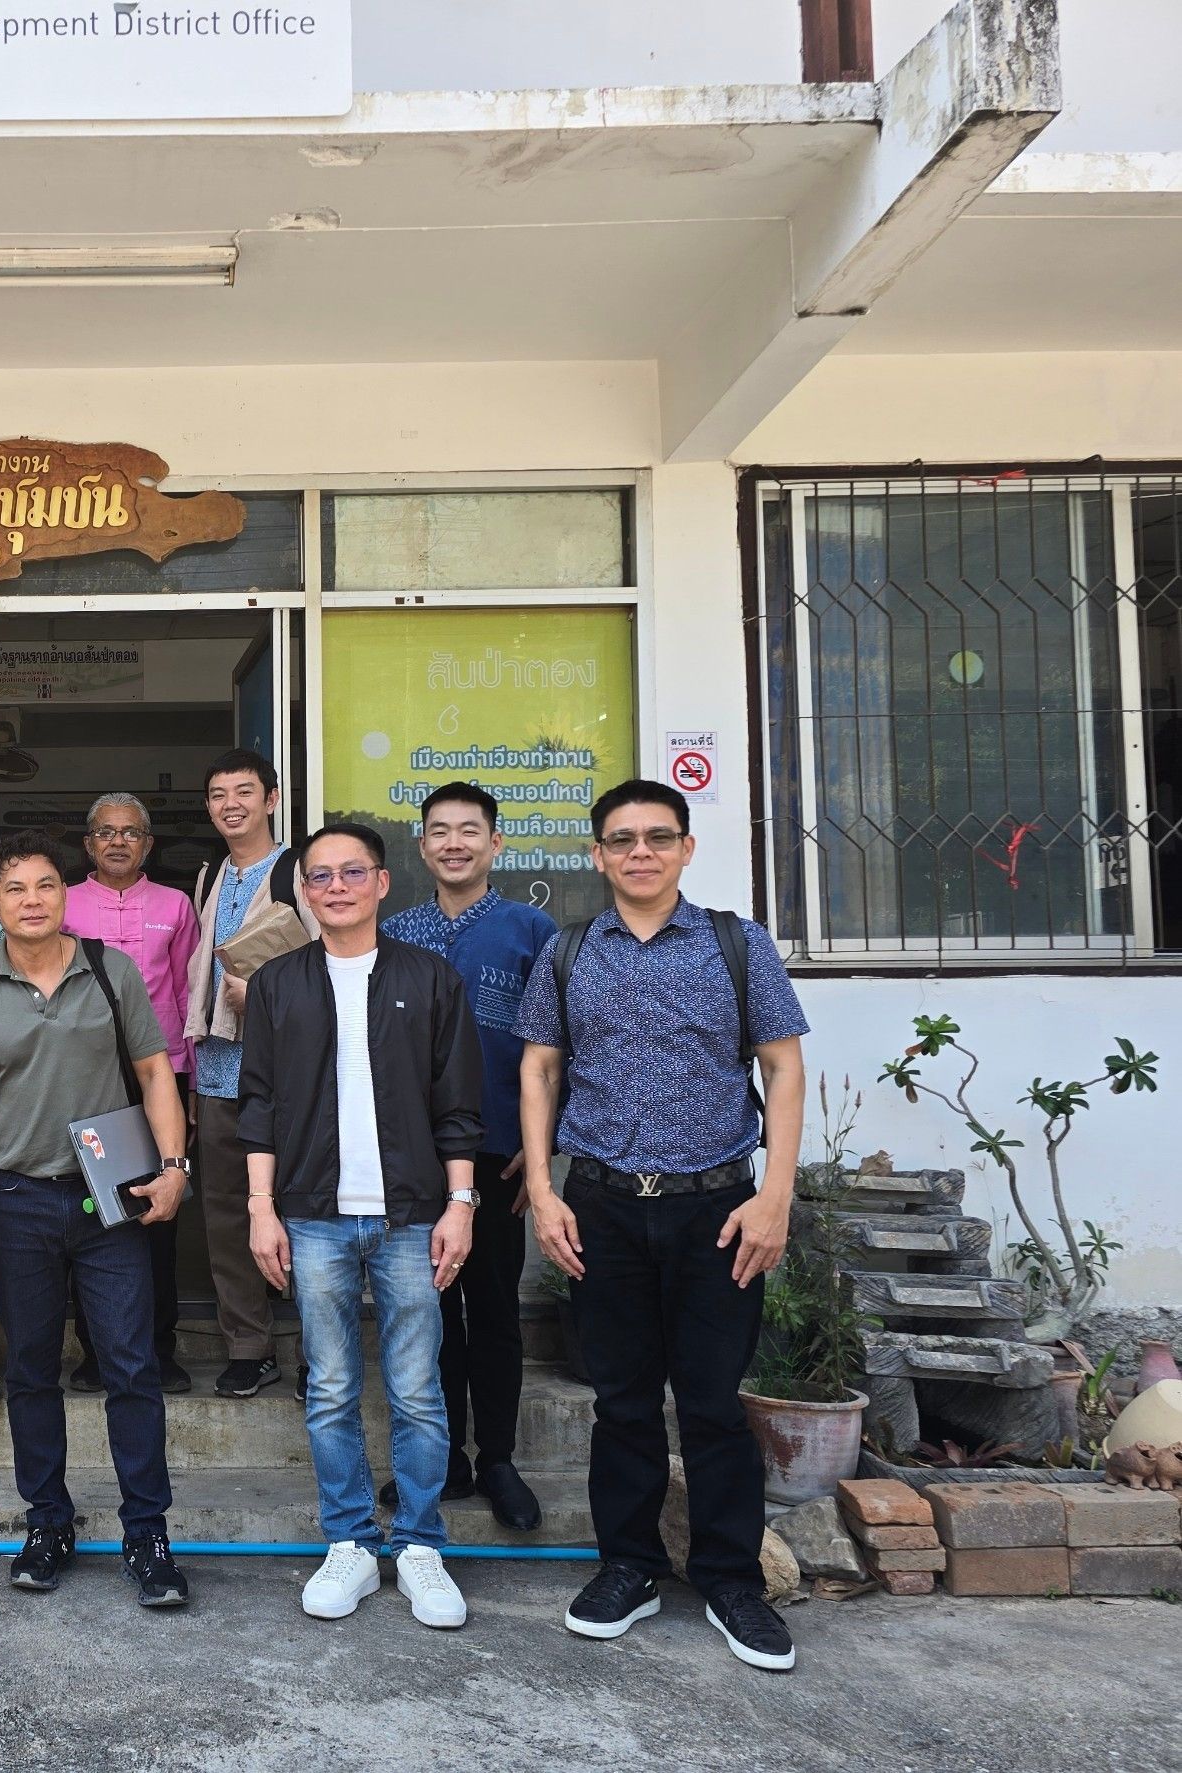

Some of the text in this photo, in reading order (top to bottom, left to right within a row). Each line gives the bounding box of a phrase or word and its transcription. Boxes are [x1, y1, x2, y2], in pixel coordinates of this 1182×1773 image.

[115, 9, 220, 36] District
[232, 8, 316, 35] Office
[427, 649, 597, 690] สันป่าตอง
